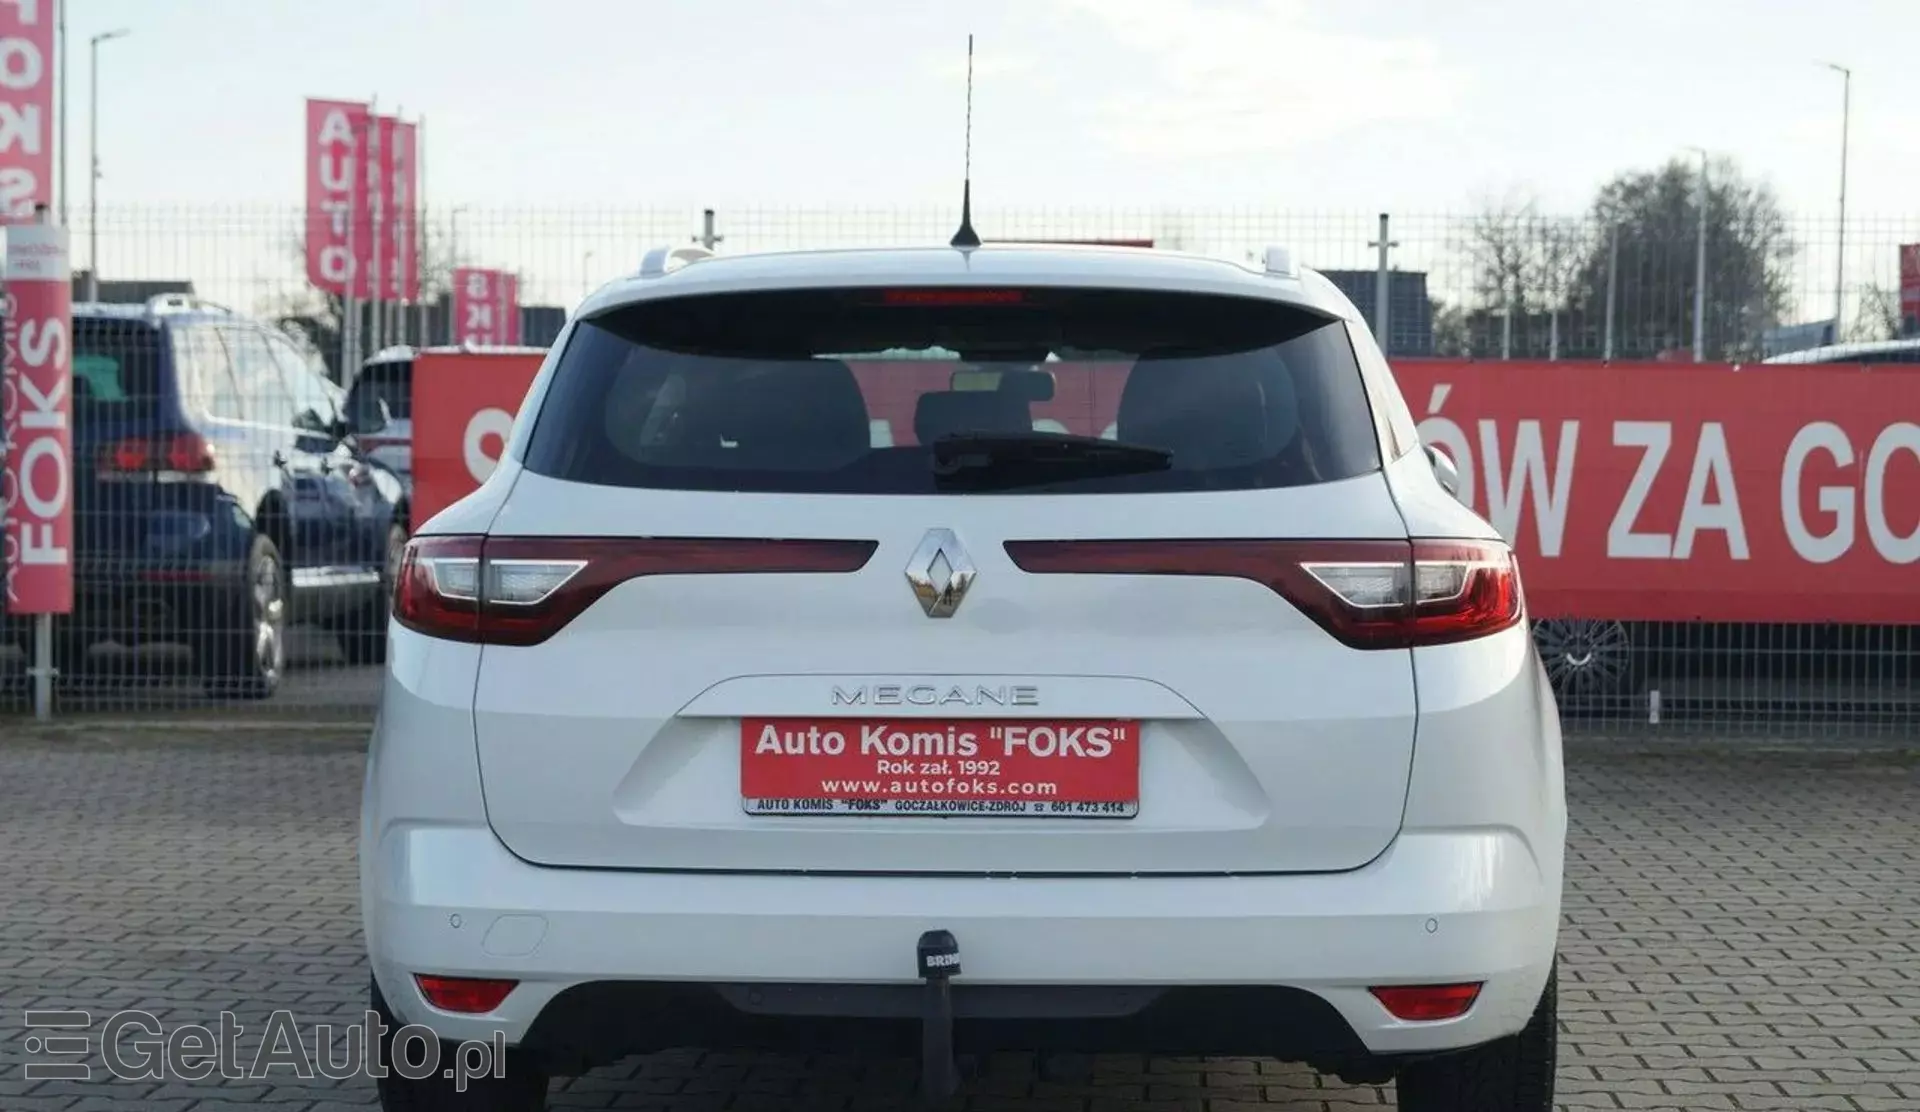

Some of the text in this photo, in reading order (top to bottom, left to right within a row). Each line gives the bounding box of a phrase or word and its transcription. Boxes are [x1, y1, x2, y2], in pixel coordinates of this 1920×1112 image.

[318, 108, 357, 283] AUTO
[19, 317, 68, 566] FOKS
[1606, 420, 1750, 560] ZA
[831, 685, 1040, 706] MEGANE
[755, 724, 1125, 758] Auto Komis "FOKS"
[876, 759, 1001, 776] Rok zał. 1992
[822, 778, 1057, 796] www.autofoks.com
[757, 798, 790, 810] AUTO
[793, 798, 833, 811] KOMIS
[1051, 801, 1073, 813] 601
[1076, 801, 1099, 813] 473
[1101, 802, 1124, 814] 414
